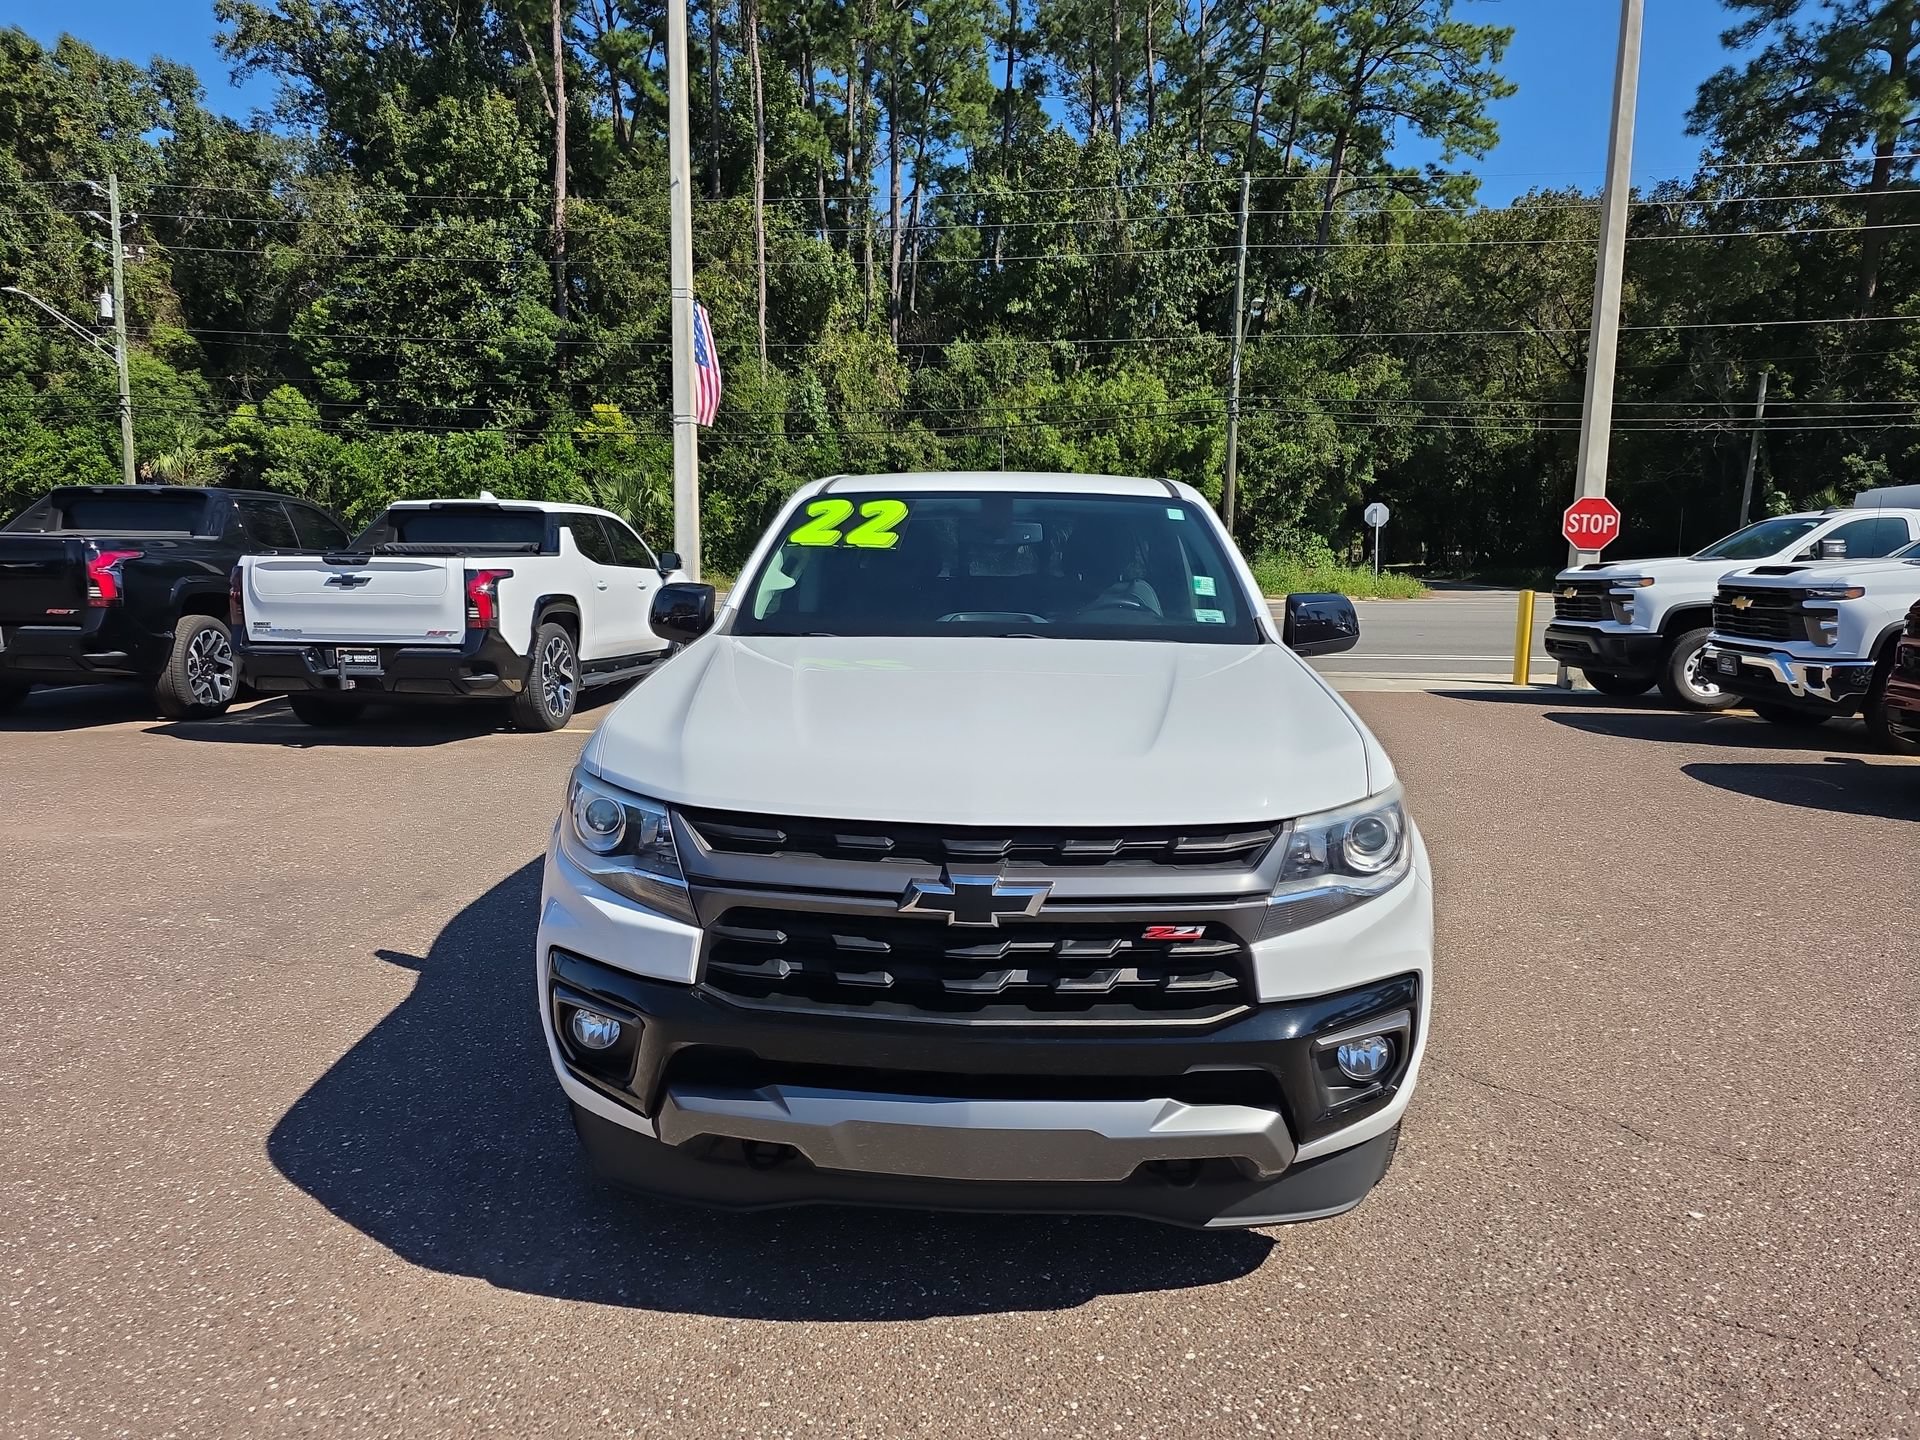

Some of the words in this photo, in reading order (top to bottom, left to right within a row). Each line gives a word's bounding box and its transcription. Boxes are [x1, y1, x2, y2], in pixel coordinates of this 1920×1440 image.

[790, 499, 909, 548] 22
[1567, 513, 1616, 534] STOP
[1141, 925, 1207, 939] Z71
